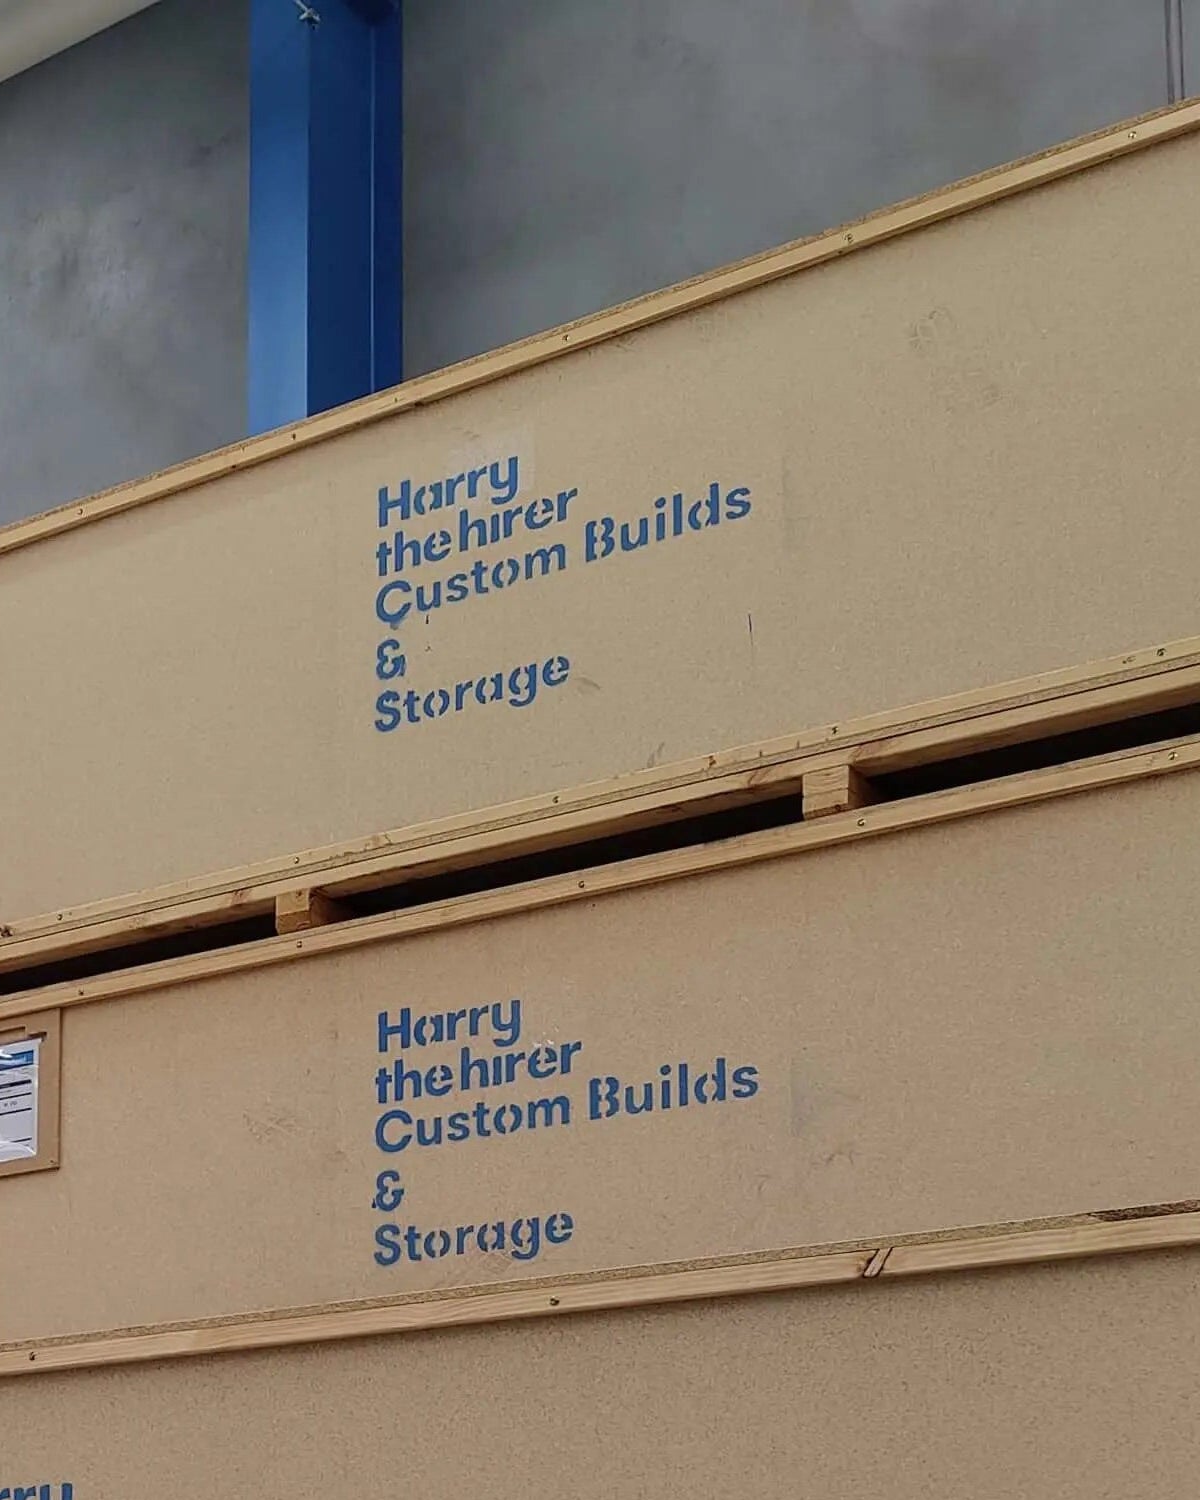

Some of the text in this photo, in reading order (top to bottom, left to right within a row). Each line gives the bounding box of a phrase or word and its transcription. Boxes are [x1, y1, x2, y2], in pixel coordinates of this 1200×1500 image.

[378, 456, 519, 528] Harry
[375, 482, 751, 626] Custom Builds
[375, 639, 406, 681] &
[375, 656, 569, 732] Storage
[378, 1001, 521, 1053] Harry
[375, 1058, 759, 1153] Custom Builds
[373, 1171, 404, 1212] &
[374, 1211, 573, 1266] Storage
